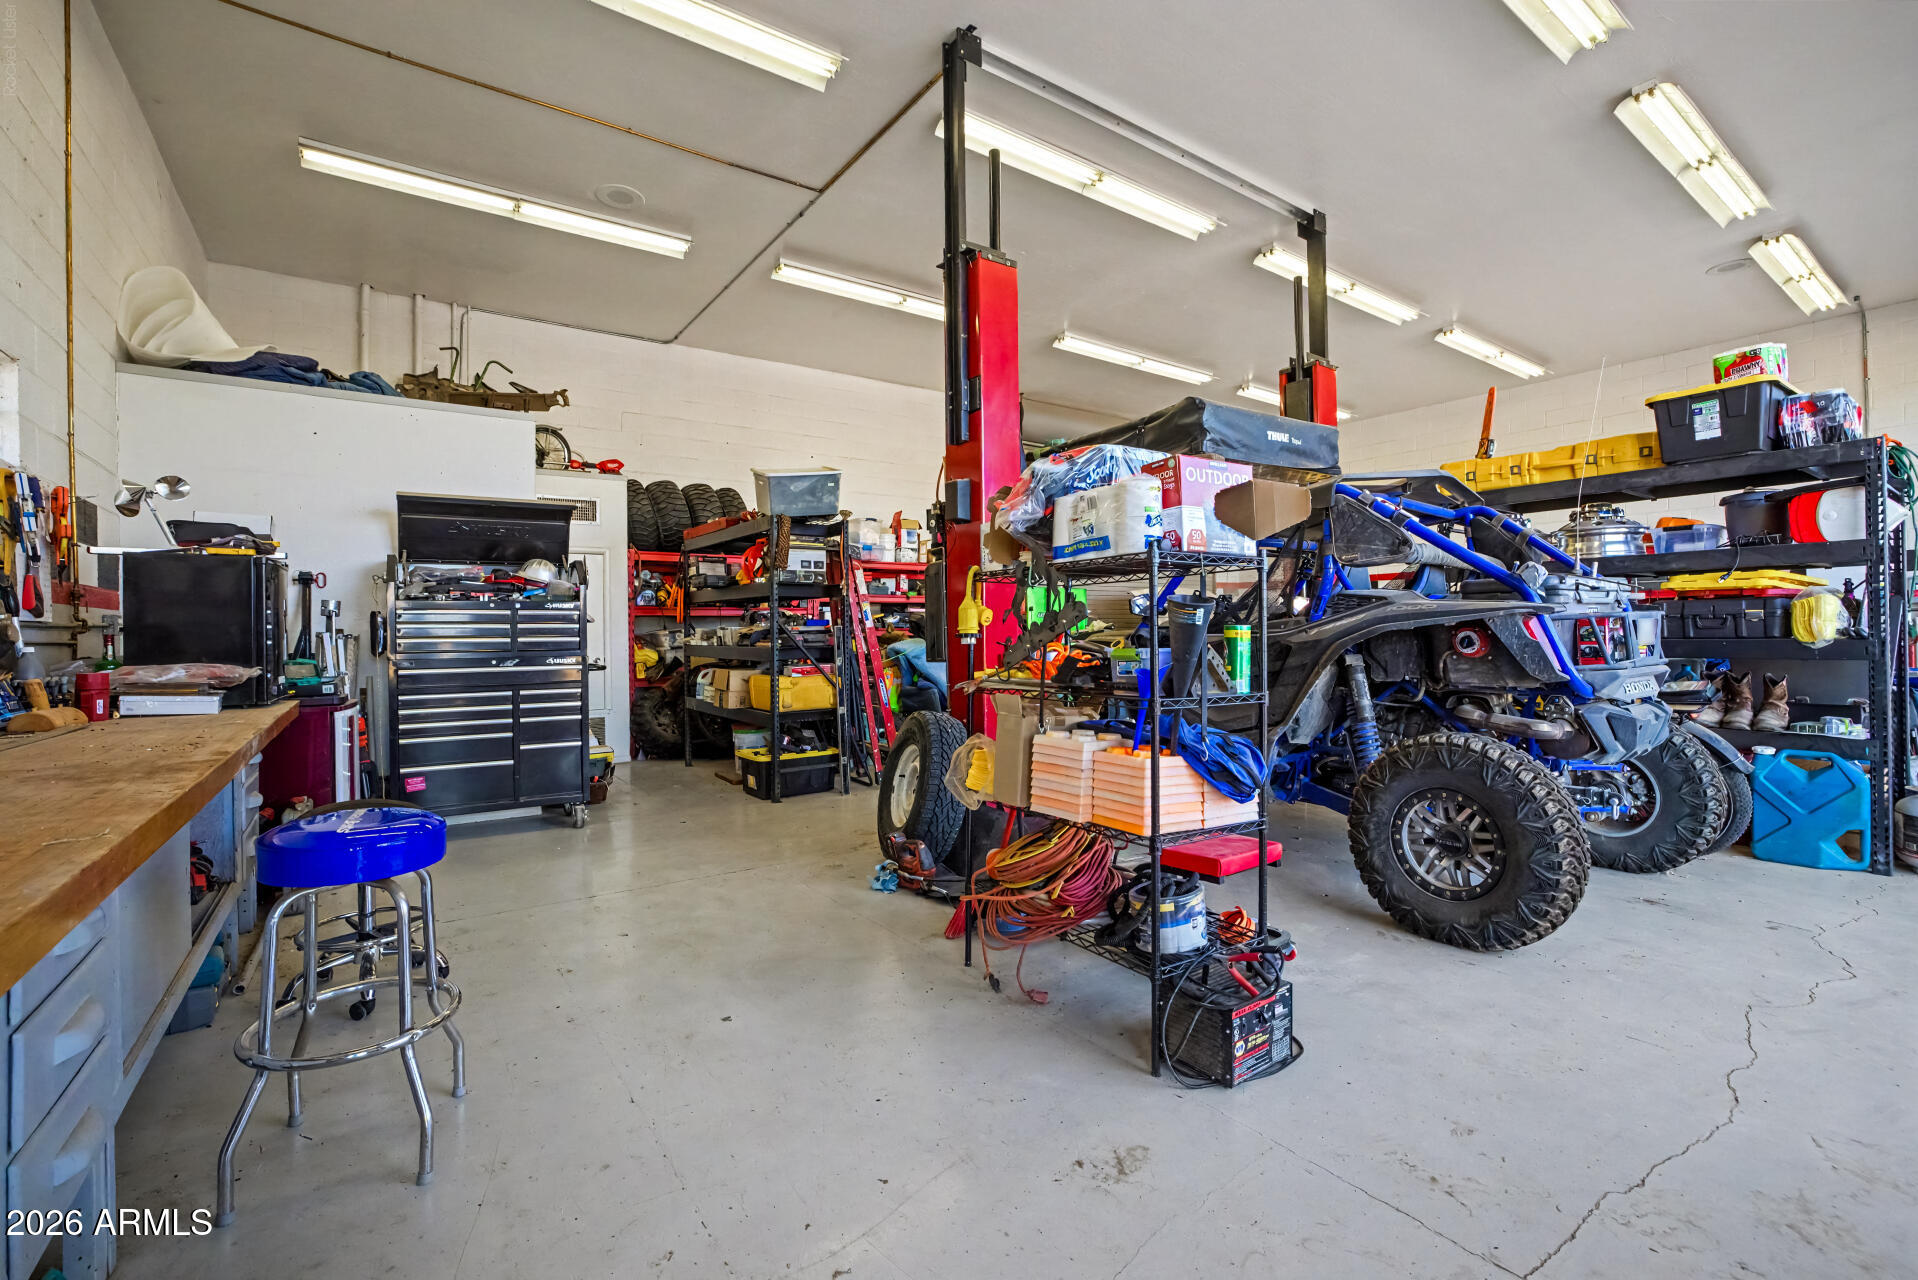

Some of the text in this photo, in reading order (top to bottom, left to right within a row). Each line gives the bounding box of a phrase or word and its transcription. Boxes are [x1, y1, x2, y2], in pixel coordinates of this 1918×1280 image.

[1731, 360, 1760, 375] BRAWNY
[1267, 430, 1290, 443] THULE
[1191, 530, 1202, 540] 50
